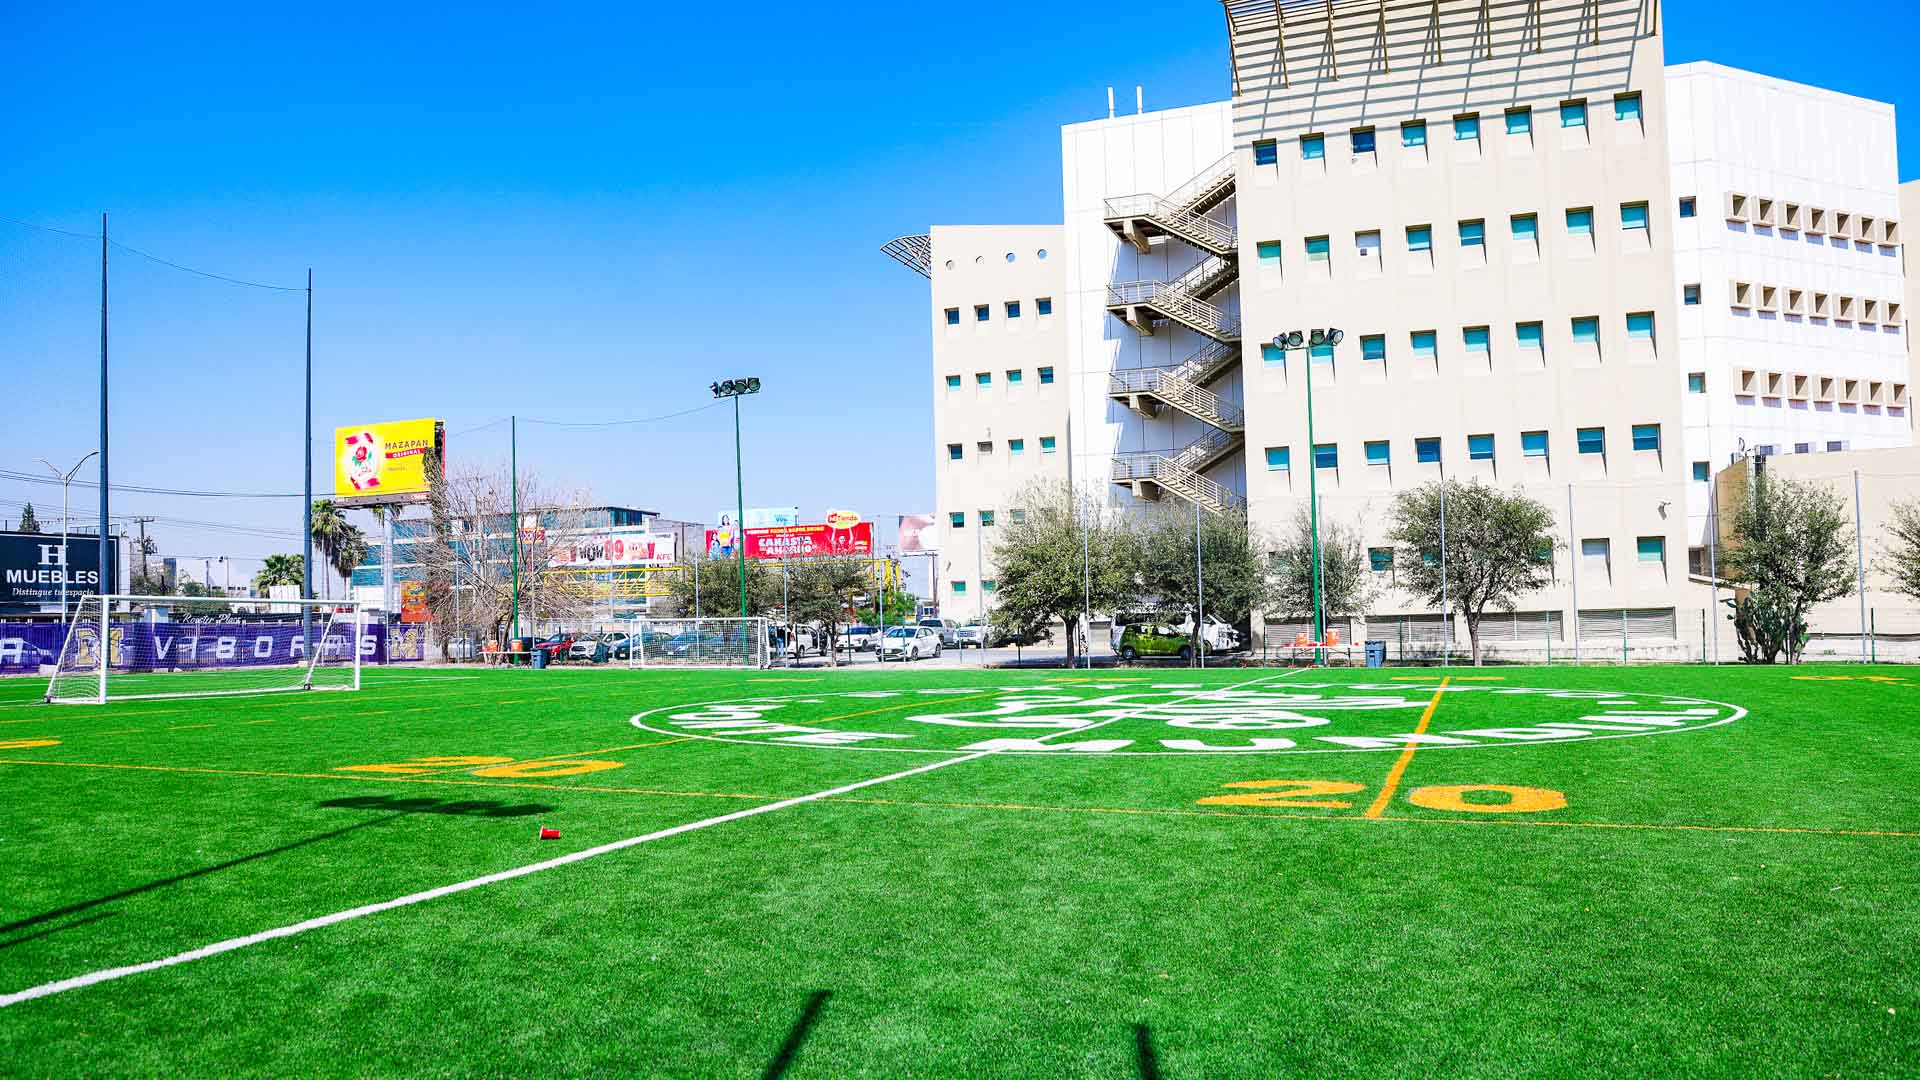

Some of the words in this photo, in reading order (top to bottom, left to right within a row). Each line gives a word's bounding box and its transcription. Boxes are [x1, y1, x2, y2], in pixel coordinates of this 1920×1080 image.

[384, 440, 429, 450] MAZAPAN
[37, 544, 69, 566] H
[6, 569, 99, 584] MUEBLES
[12, 587, 53, 598] Distingue
[333, 755, 626, 778] 20
[1195, 779, 1569, 814] 20
